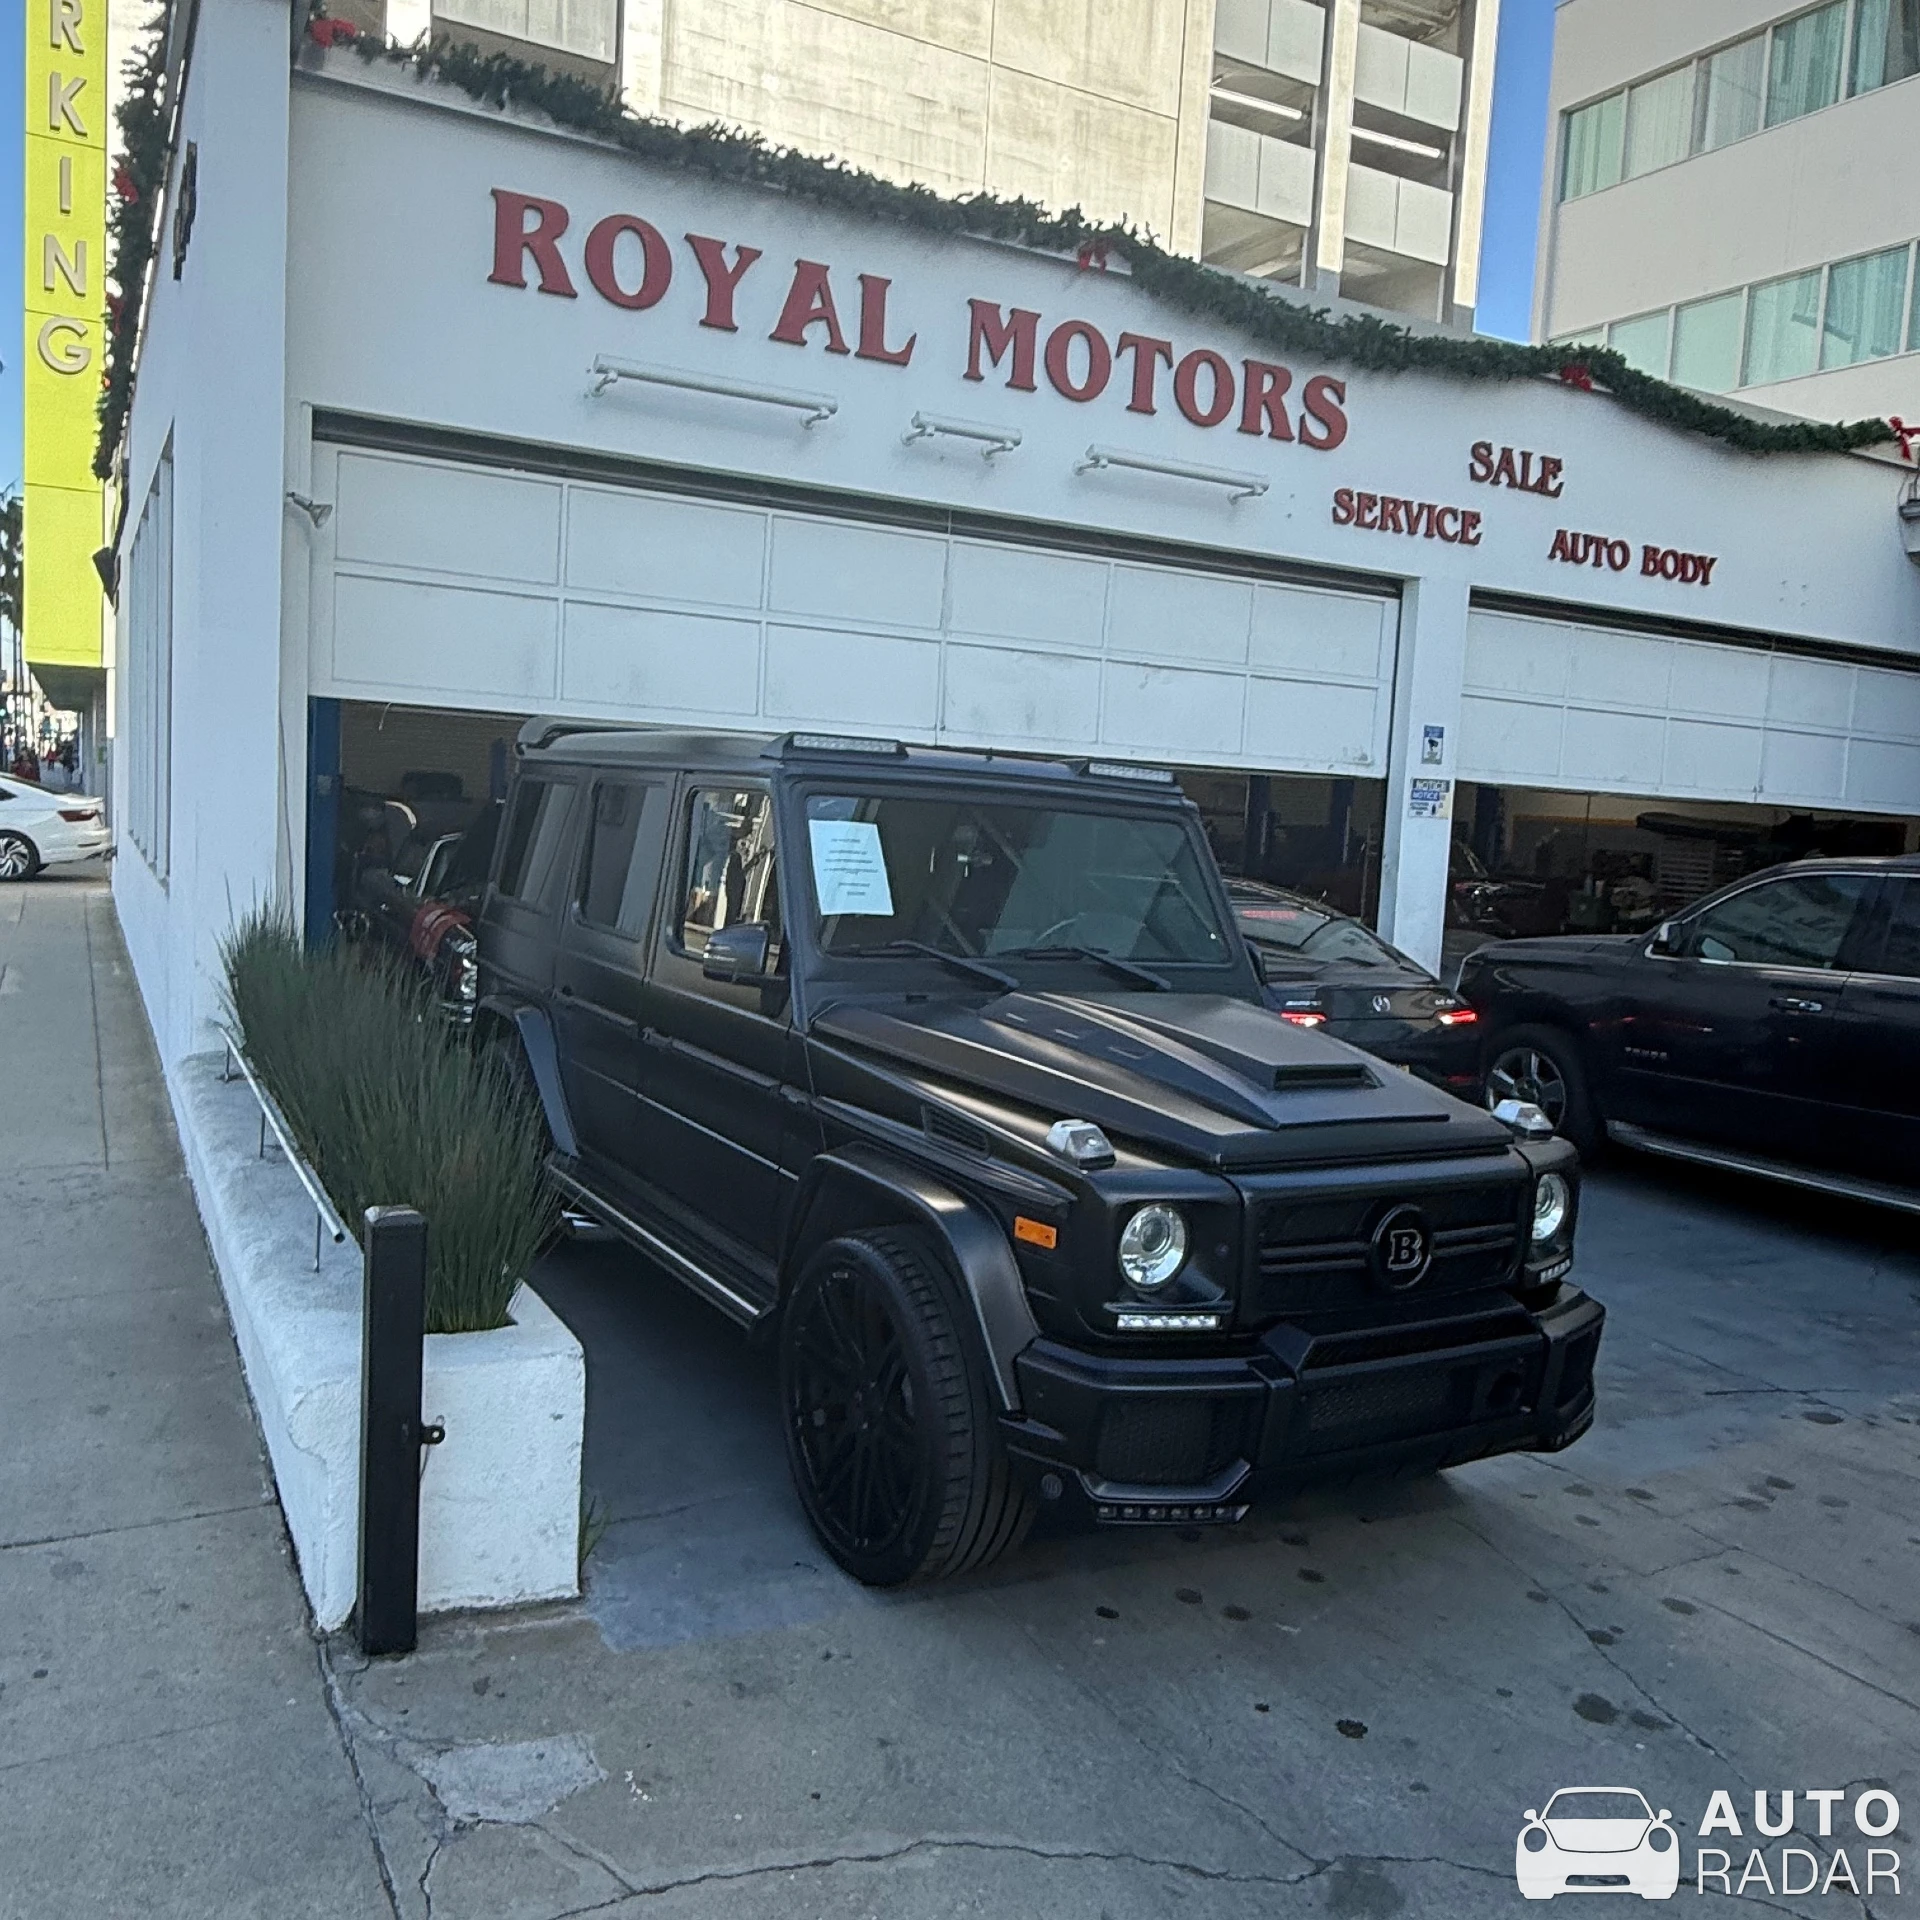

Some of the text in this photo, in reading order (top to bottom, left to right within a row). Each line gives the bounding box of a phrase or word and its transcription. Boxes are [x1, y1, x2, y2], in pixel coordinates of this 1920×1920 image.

[487, 187, 1349, 450] ROYAL MOTORS
[1469, 440, 1565, 498] SALE
[1332, 488, 1482, 546] SERVICE
[1548, 529, 1718, 586] AUTO BODY
[1387, 1229, 1422, 1271] B
